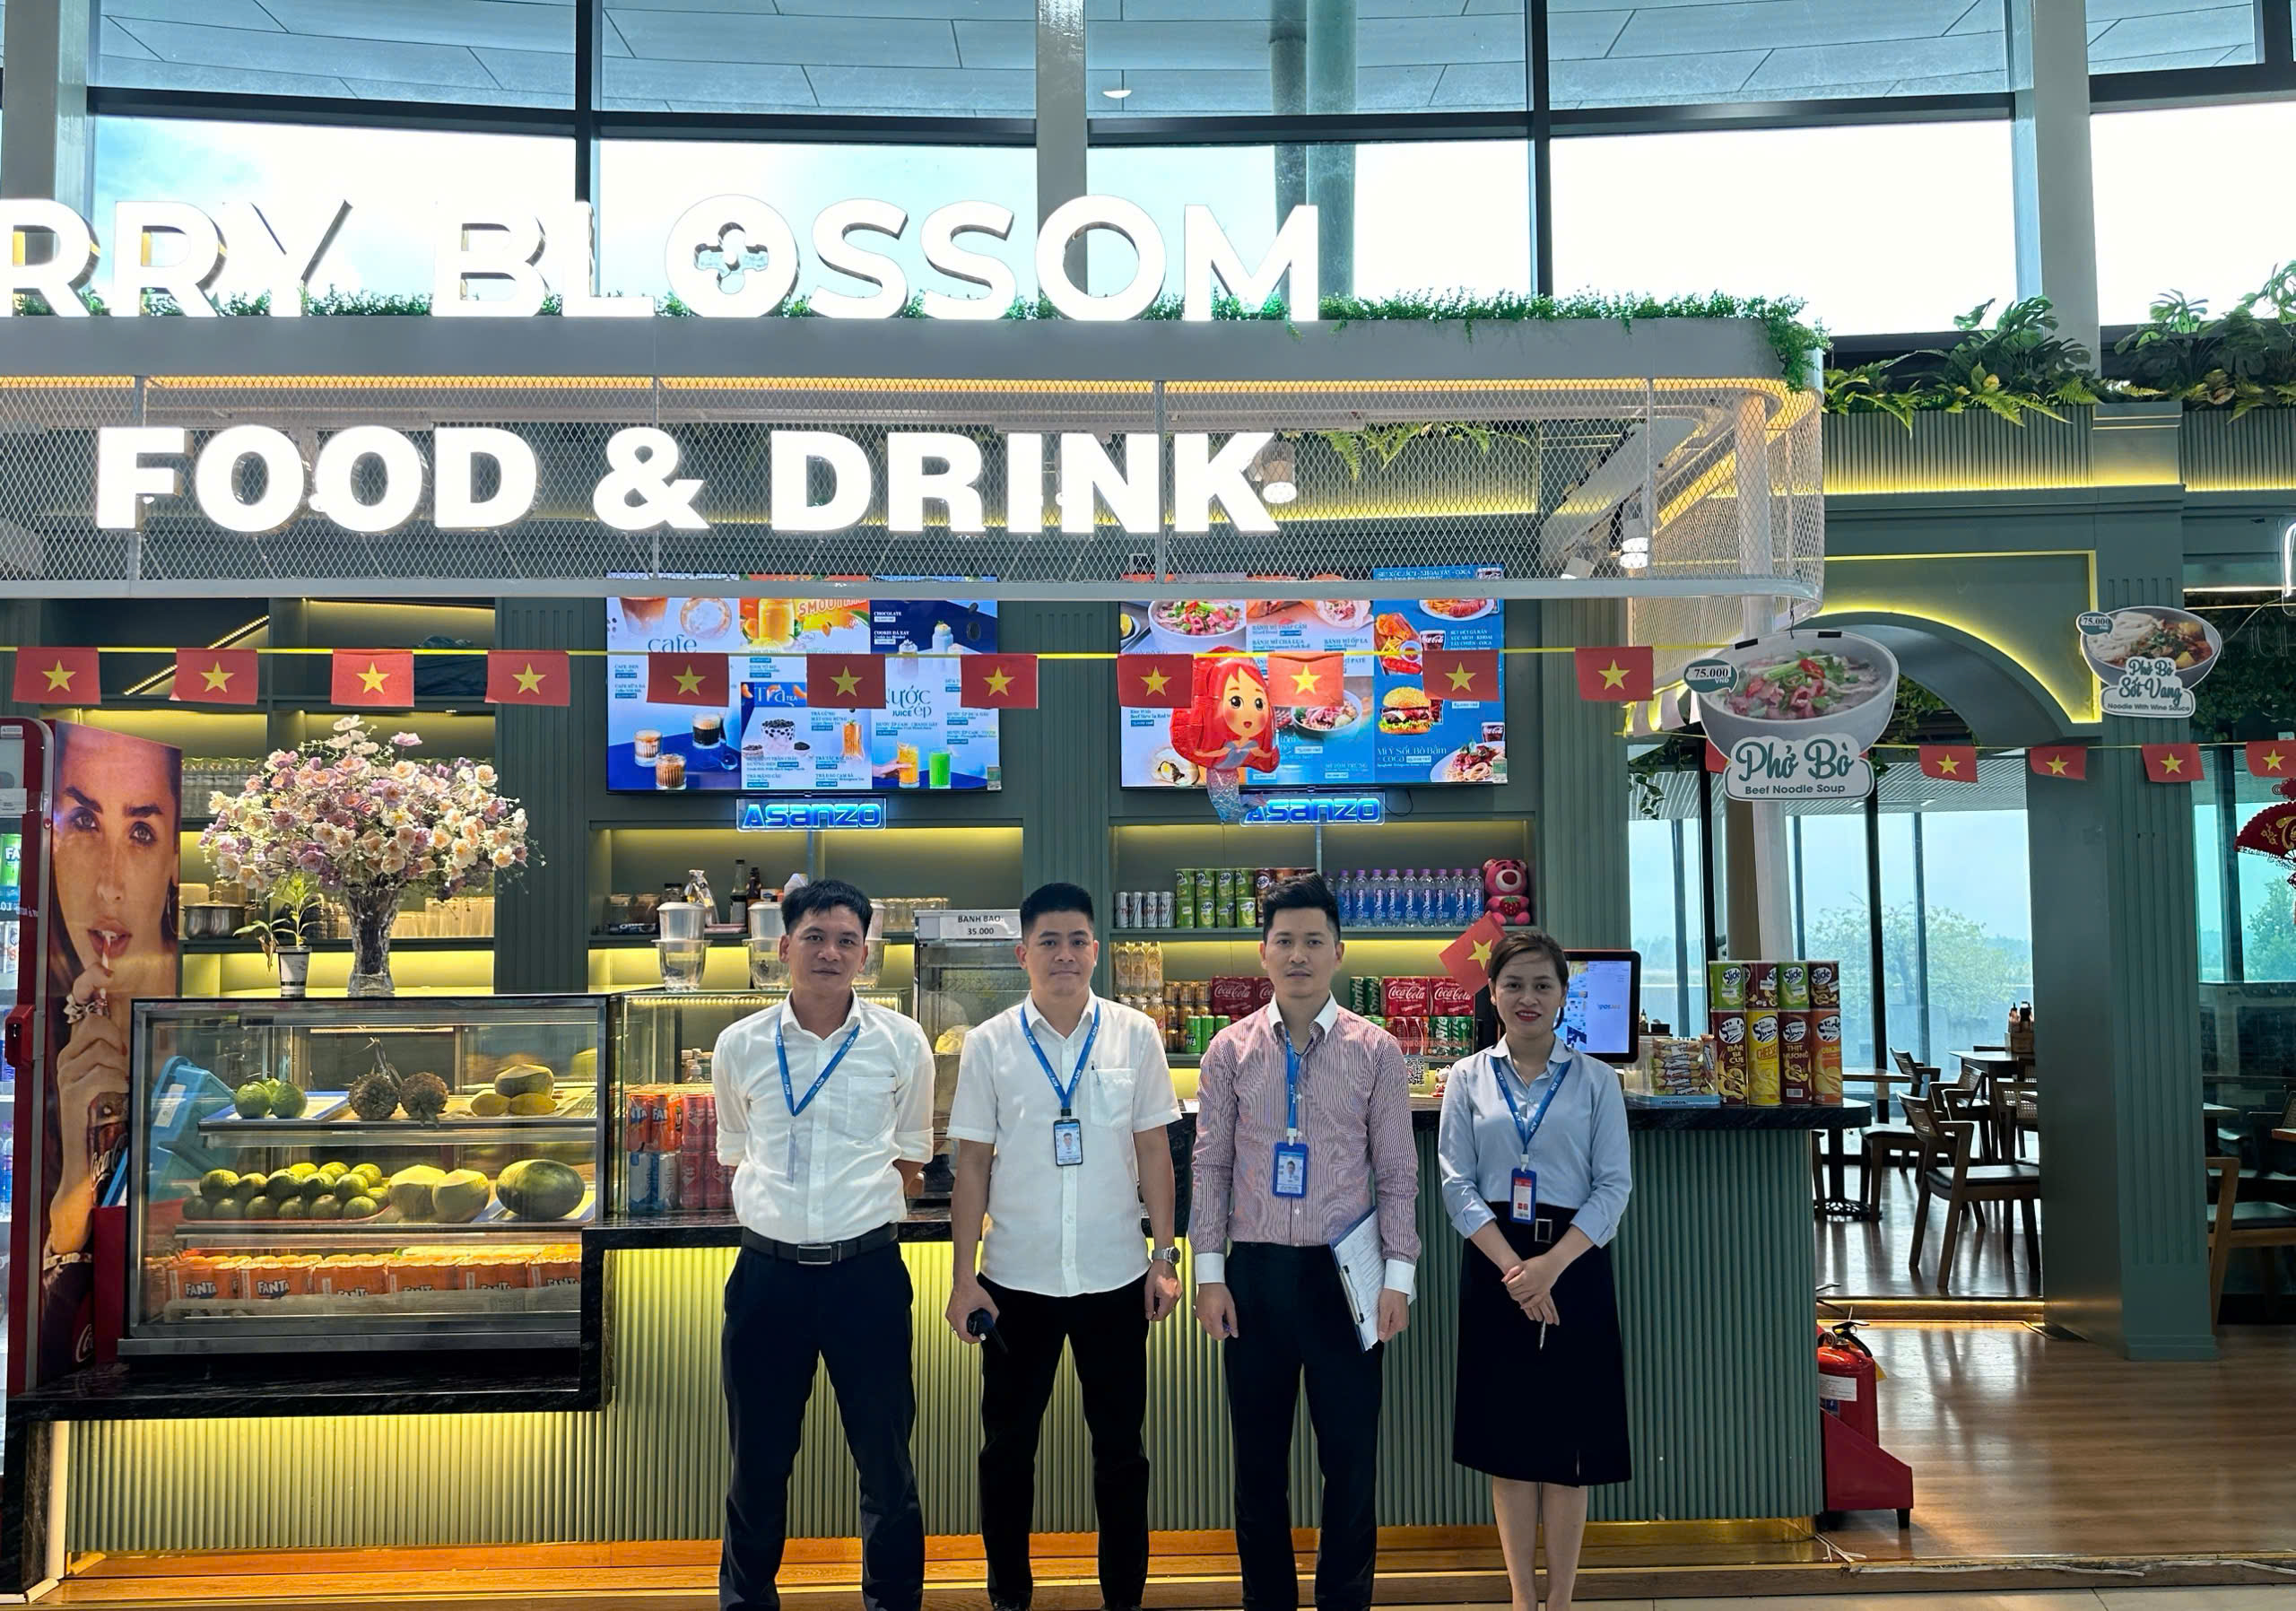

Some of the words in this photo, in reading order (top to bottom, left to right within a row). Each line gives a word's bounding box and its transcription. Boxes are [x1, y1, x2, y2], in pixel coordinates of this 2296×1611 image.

[0, 199, 353, 317] RRY
[432, 194, 1319, 321] BLOSSOM
[97, 425, 537, 533] FOOD
[593, 426, 710, 531] &
[770, 431, 1281, 534] DRINK
[2083, 617, 2111, 625] 75.000
[1693, 667, 1729, 678] 75.000
[2128, 659, 2153, 675] Phở
[2154, 660, 2173, 676] Bò
[886, 684, 932, 710] ước
[2141, 677, 2182, 706] Vang
[2135, 702, 2149, 710] With
[1735, 741, 1798, 781] Phở
[1804, 738, 1854, 779] Bò
[1744, 786, 1770, 795] Beef
[1772, 784, 1813, 795] Noodle
[1816, 783, 1846, 795] Soup
[1723, 970, 1741, 983] Slide
[1783, 969, 1802, 982] Slide
[1812, 970, 1830, 982] Slide
[185, 1280, 217, 1296] FANTA
[257, 1279, 290, 1296] FANTA
